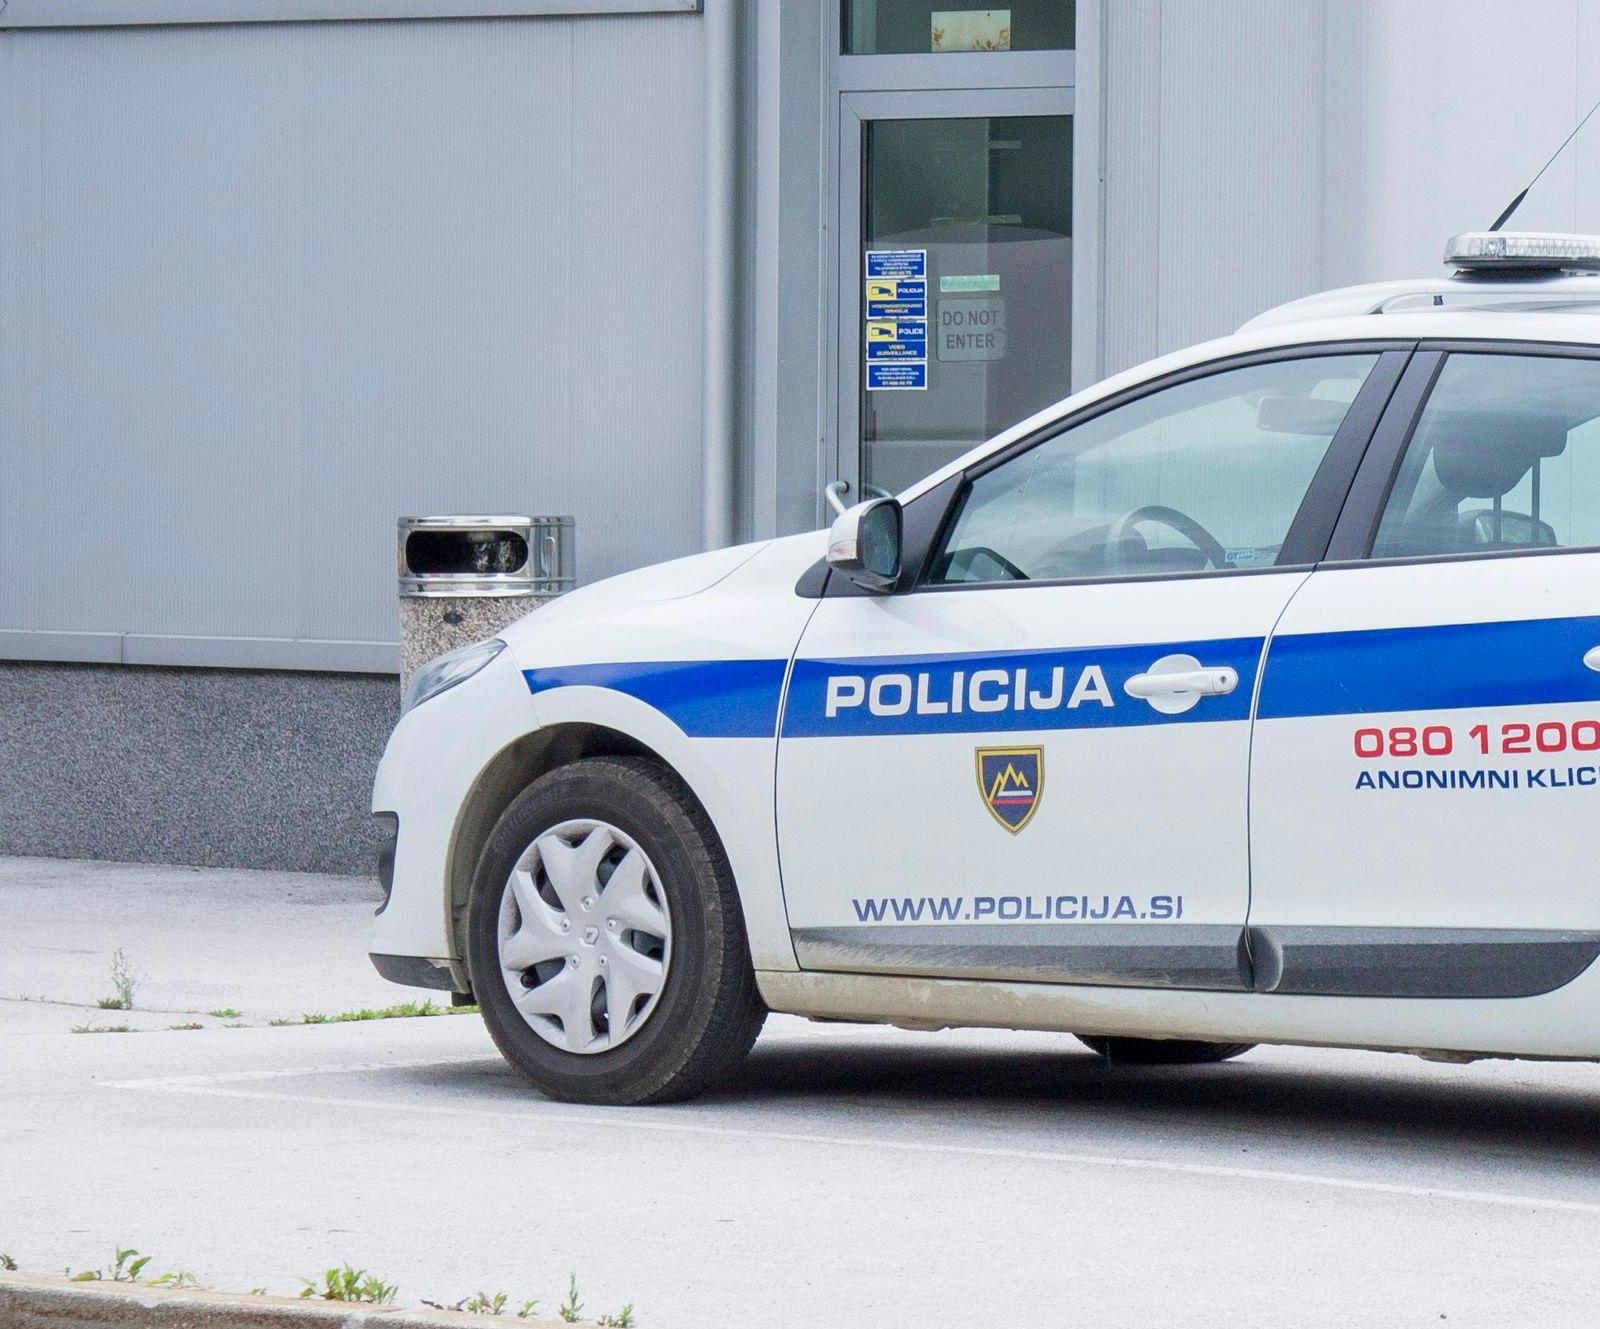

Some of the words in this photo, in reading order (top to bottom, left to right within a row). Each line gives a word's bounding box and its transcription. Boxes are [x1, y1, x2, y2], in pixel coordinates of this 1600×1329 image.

[942, 310, 964, 327] DO
[968, 309, 999, 326] NOT
[898, 327, 924, 335] POLICE
[946, 333, 996, 350] ENTER
[825, 665, 1115, 718] POLICIJA
[1354, 725, 1453, 758] 080
[1355, 769, 1519, 790] ANONIMNI
[852, 895, 1184, 922] WWW.POLICIJA.SI
